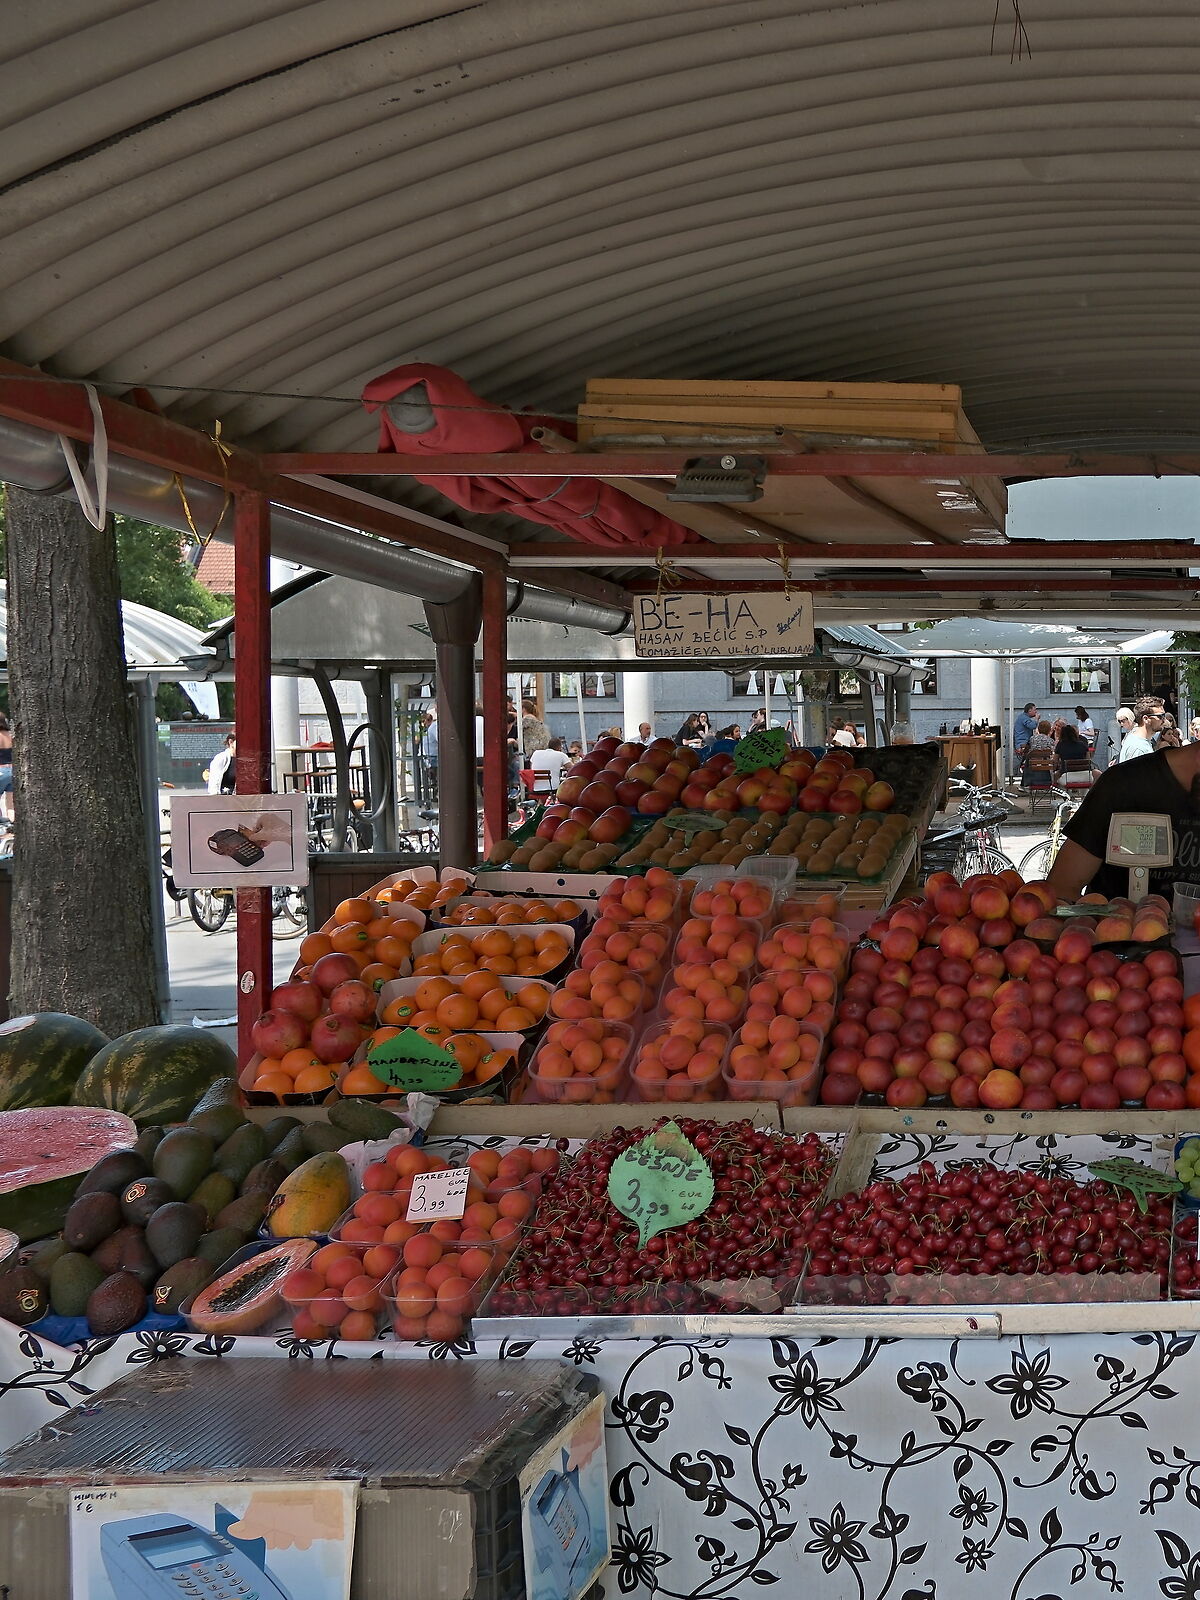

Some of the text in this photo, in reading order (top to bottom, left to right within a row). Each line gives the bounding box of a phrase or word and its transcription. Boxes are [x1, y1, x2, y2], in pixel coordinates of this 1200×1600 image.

[640, 596, 759, 631] BE-HA
[639, 631, 684, 645] HASAN
[414, 1168, 470, 1181] MARELICE
[410, 1185, 445, 1212] 3,99
[621, 1179, 669, 1217] 3,99
